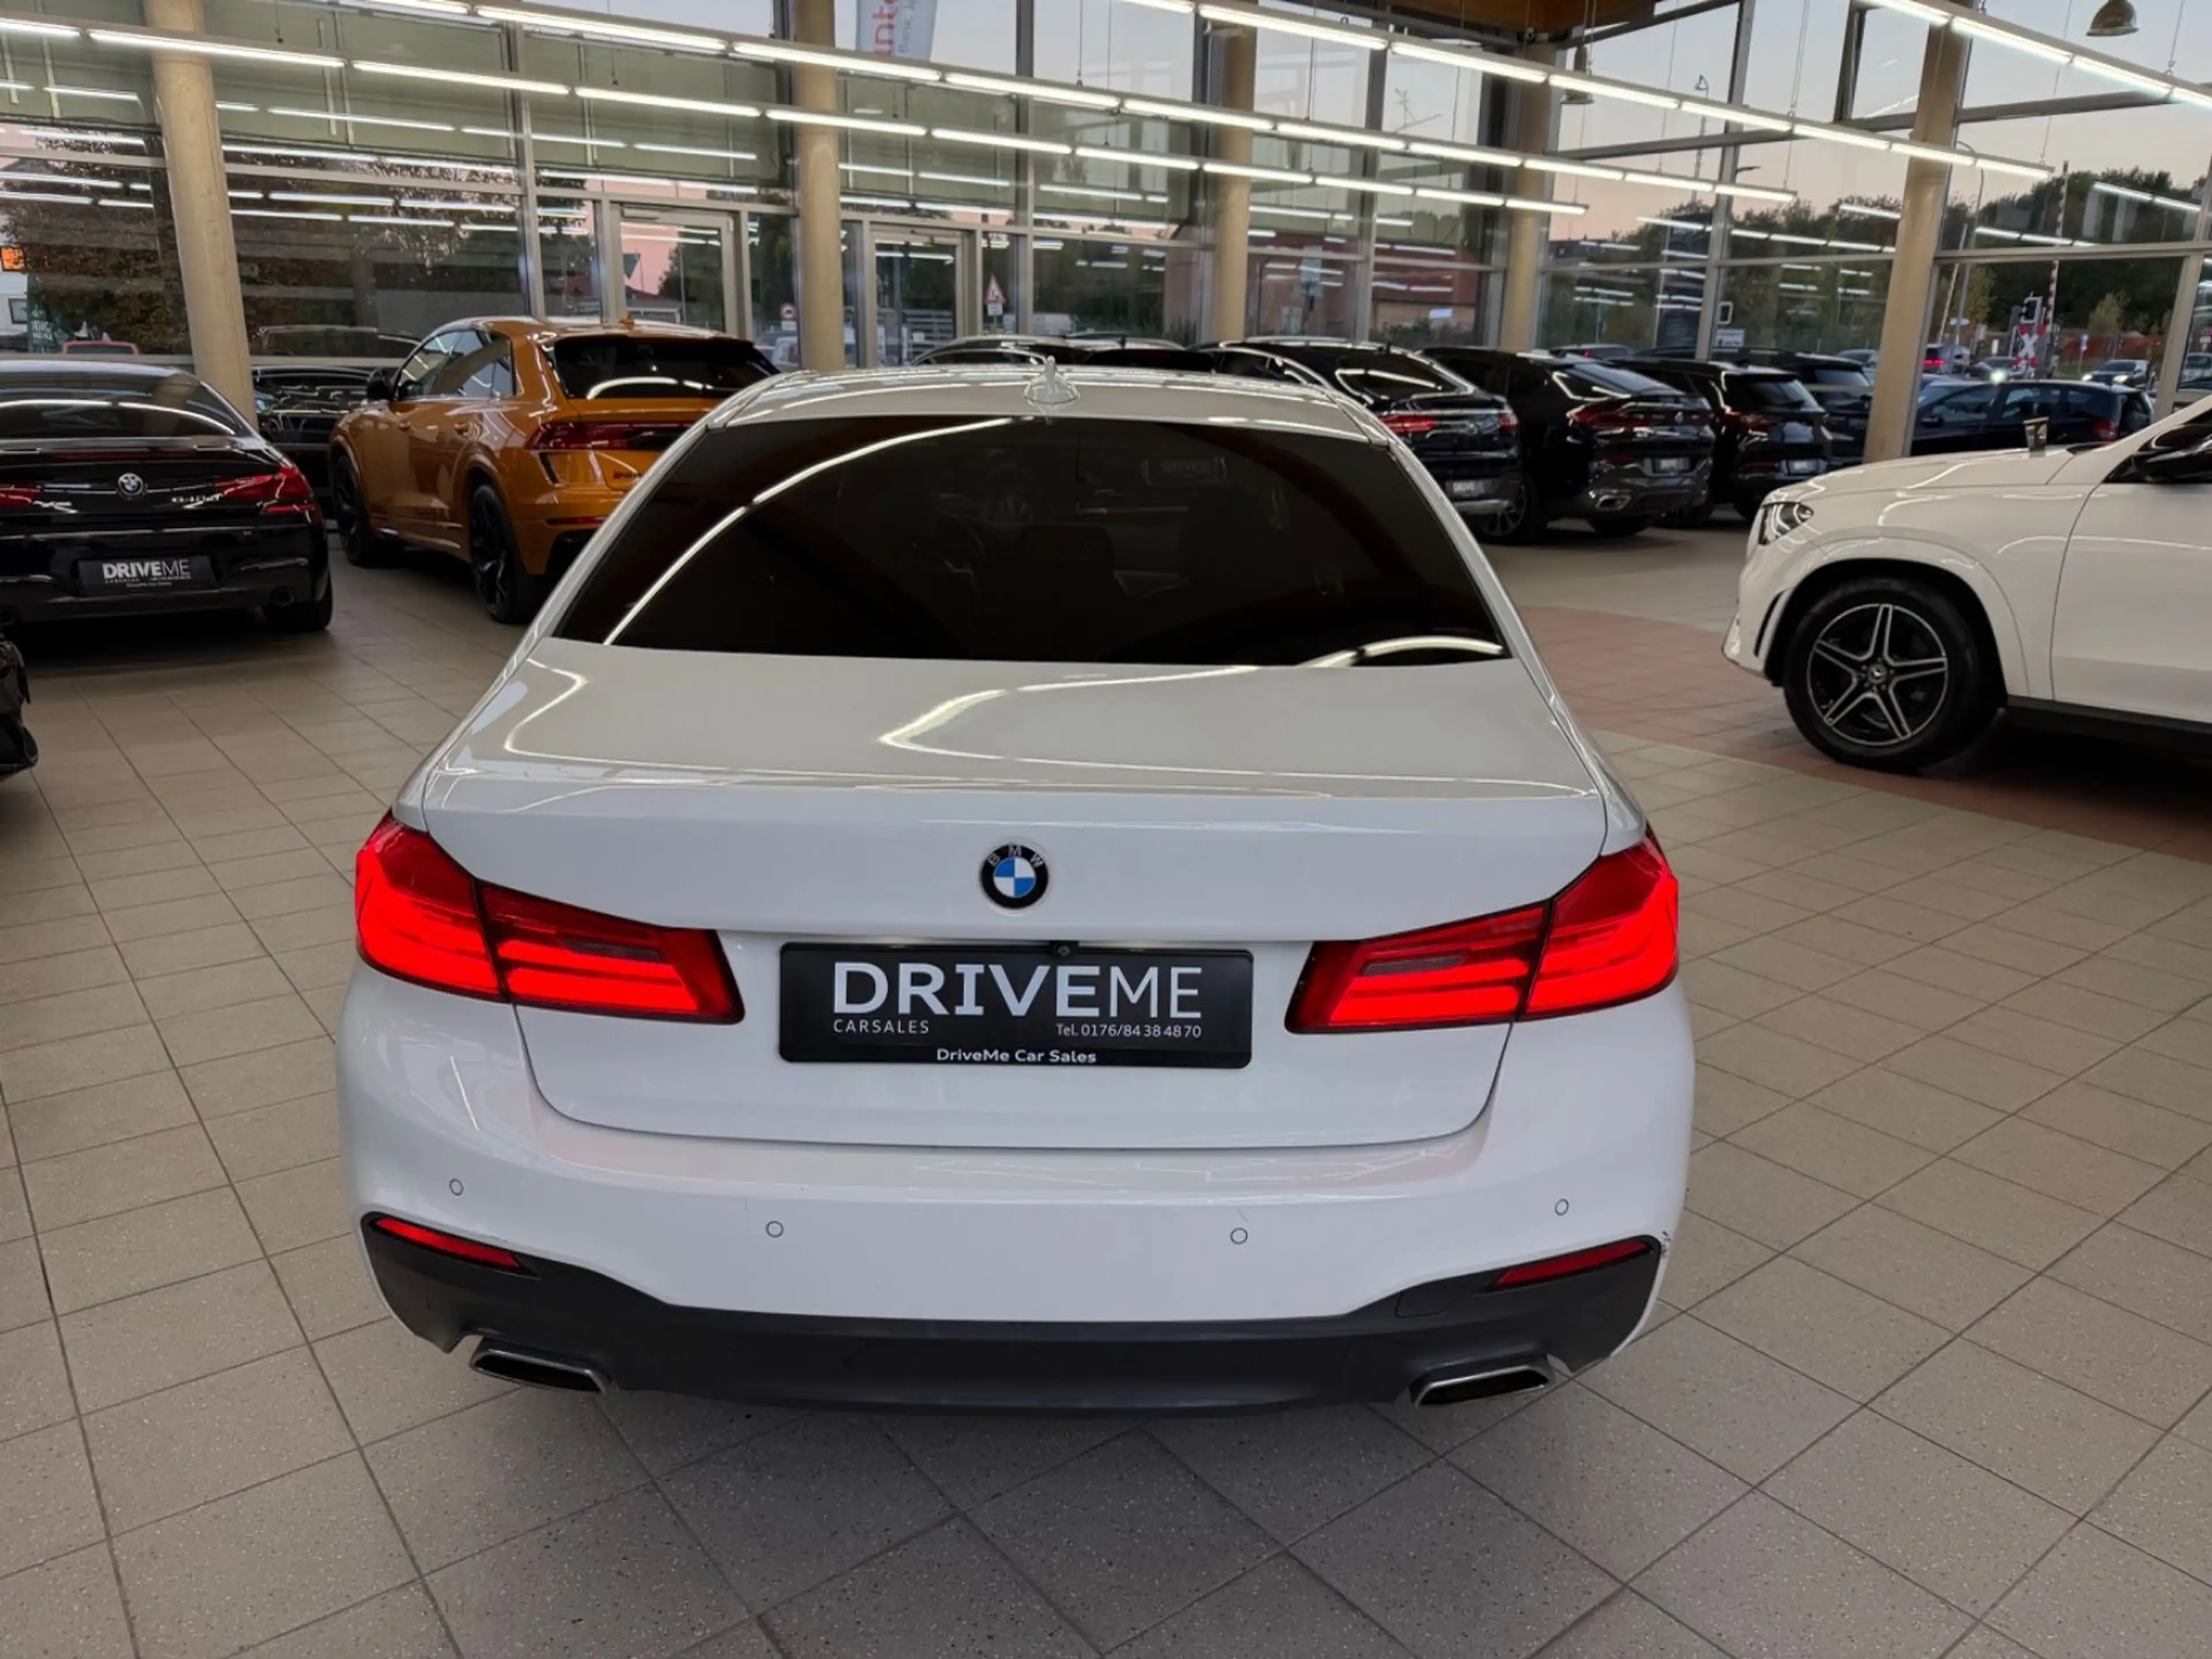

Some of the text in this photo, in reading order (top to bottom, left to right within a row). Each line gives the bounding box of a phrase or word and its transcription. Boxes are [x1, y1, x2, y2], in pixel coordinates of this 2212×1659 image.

[103, 559, 191, 579] DRIVEME
[988, 844, 1044, 868] BMW
[834, 963, 1202, 1018] DRIVEME
[834, 1019, 929, 1033] CARSALES
[937, 1049, 1096, 1063] DriveMe Car Sales
